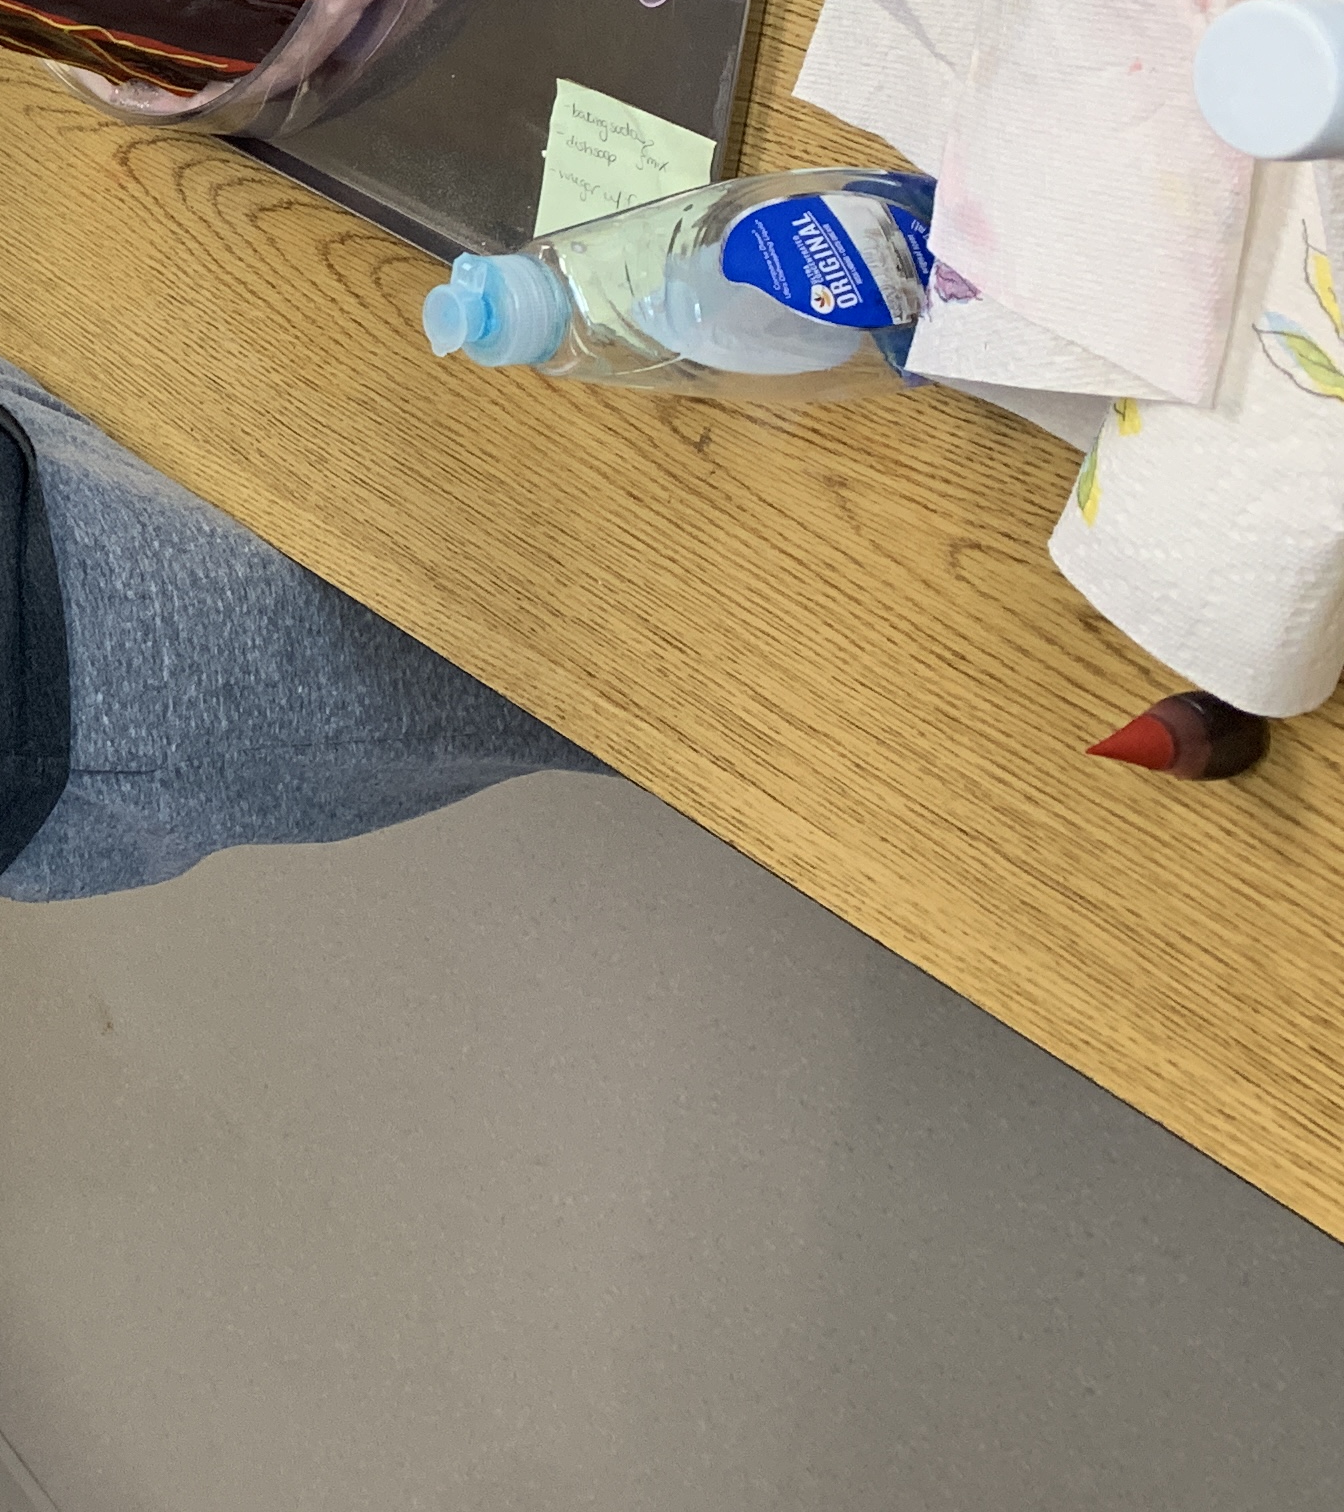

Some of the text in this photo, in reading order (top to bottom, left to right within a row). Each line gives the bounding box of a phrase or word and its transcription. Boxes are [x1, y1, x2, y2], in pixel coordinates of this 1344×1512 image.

[763, 250, 770, 260] to
[907, 233, 920, 250] scent
[766, 240, 786, 282] Dishwashing
[791, 210, 859, 309] ORIGINAL
[792, 233, 825, 283] CONCENTRATED
[915, 249, 928, 274] original
[765, 258, 781, 291] Compare
[781, 280, 792, 299] Ultra
